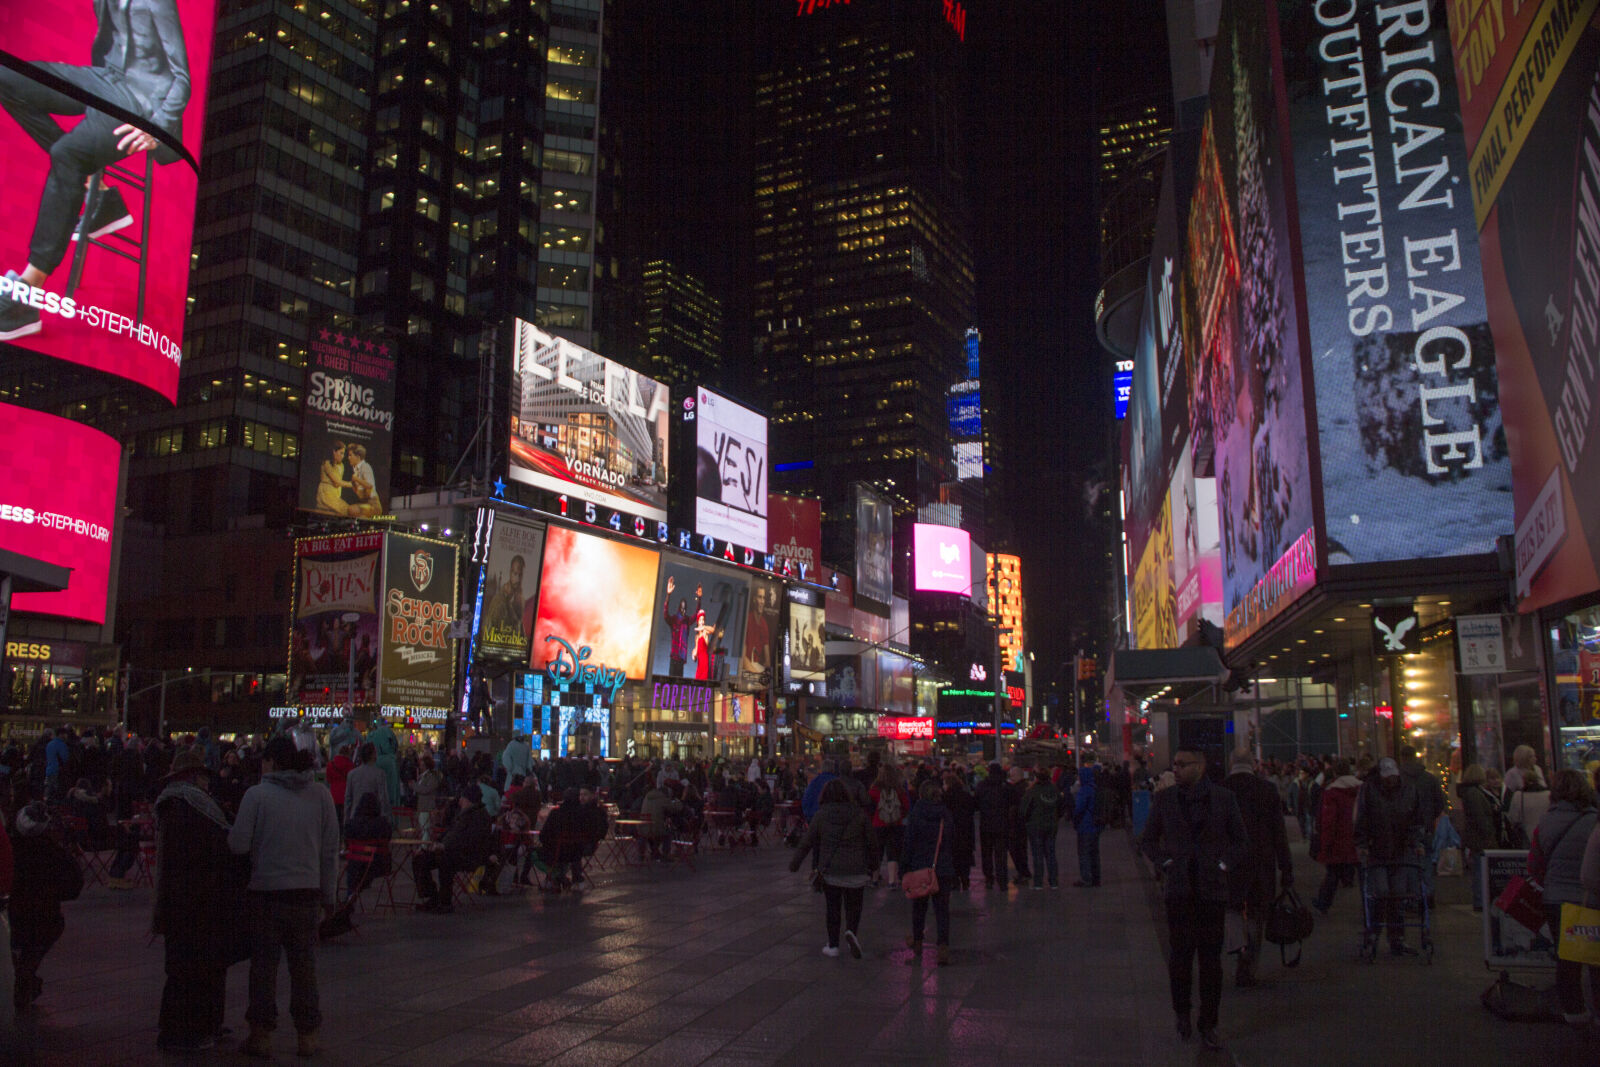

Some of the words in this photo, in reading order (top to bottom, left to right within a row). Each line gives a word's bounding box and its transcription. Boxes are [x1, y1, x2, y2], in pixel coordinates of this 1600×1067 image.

[1474, 125, 1507, 205] FINAL
[1402, 228, 1484, 476] EAGLE
[310, 371, 375, 406] SPRING
[306, 394, 395, 432] awakening
[684, 411, 695, 421] LG
[564, 456, 626, 487] VORNADO
[714, 431, 763, 515] YES!
[558, 494, 646, 537] 1540
[656, 520, 809, 581] BROADWAY
[772, 543, 813, 561] SAVIOR
[386, 588, 453, 622] SCHOOL
[391, 615, 450, 649] ROCK
[269, 706, 298, 719] GIFTS
[380, 706, 405, 718] GIFTS
[410, 708, 448, 720] LUGGAGE
[652, 683, 714, 713] FOREVER
